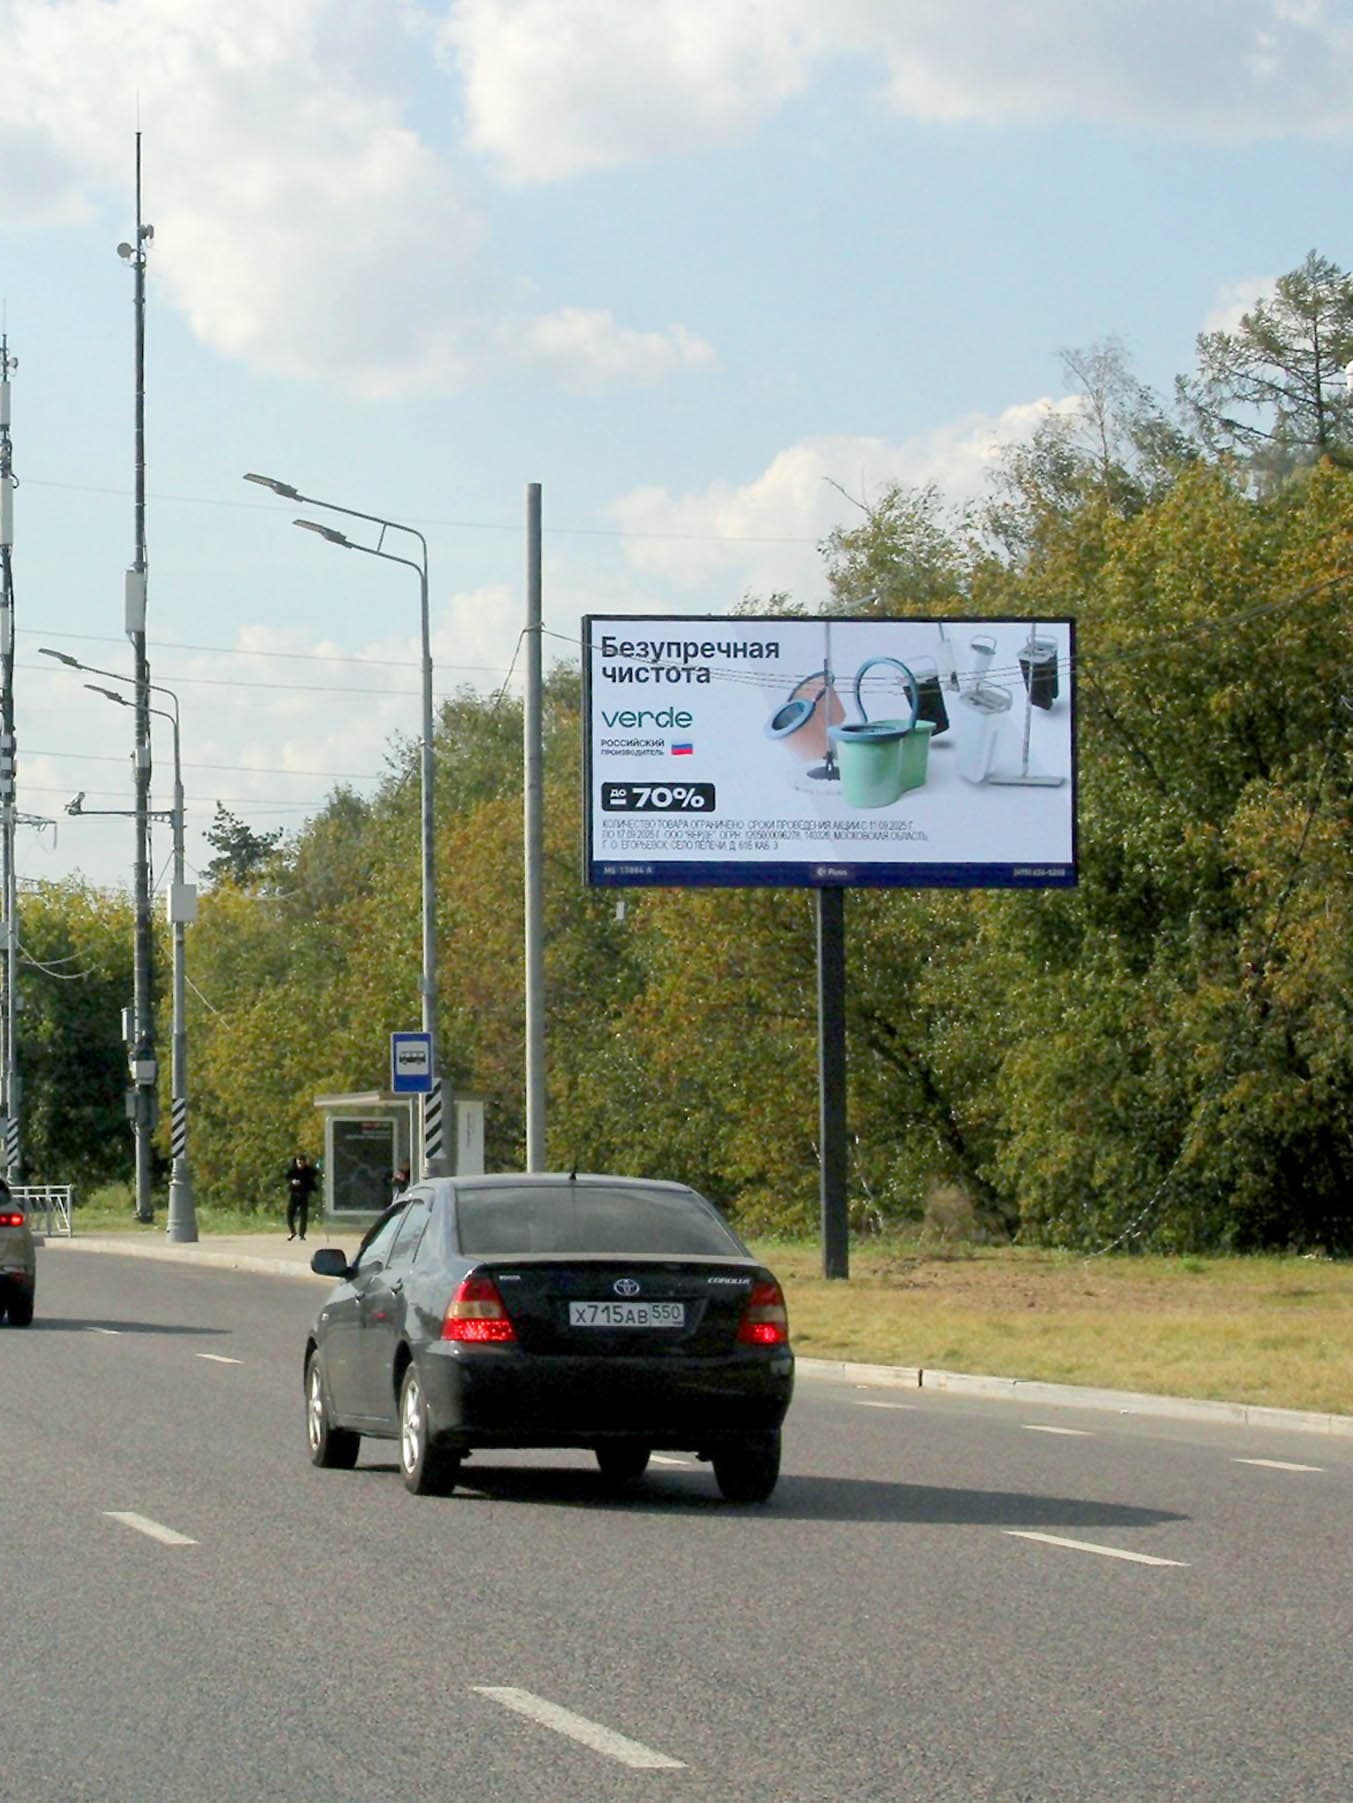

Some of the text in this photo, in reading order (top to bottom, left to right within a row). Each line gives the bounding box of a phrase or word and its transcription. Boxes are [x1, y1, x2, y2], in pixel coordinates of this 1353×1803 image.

[601, 636, 780, 664] Безупречная
[602, 666, 711, 684] чистота
[601, 706, 693, 729] verde
[600, 738, 665, 748] РОССИЙСКИЙ
[575, 1304, 681, 1325] Х715АВ 550
